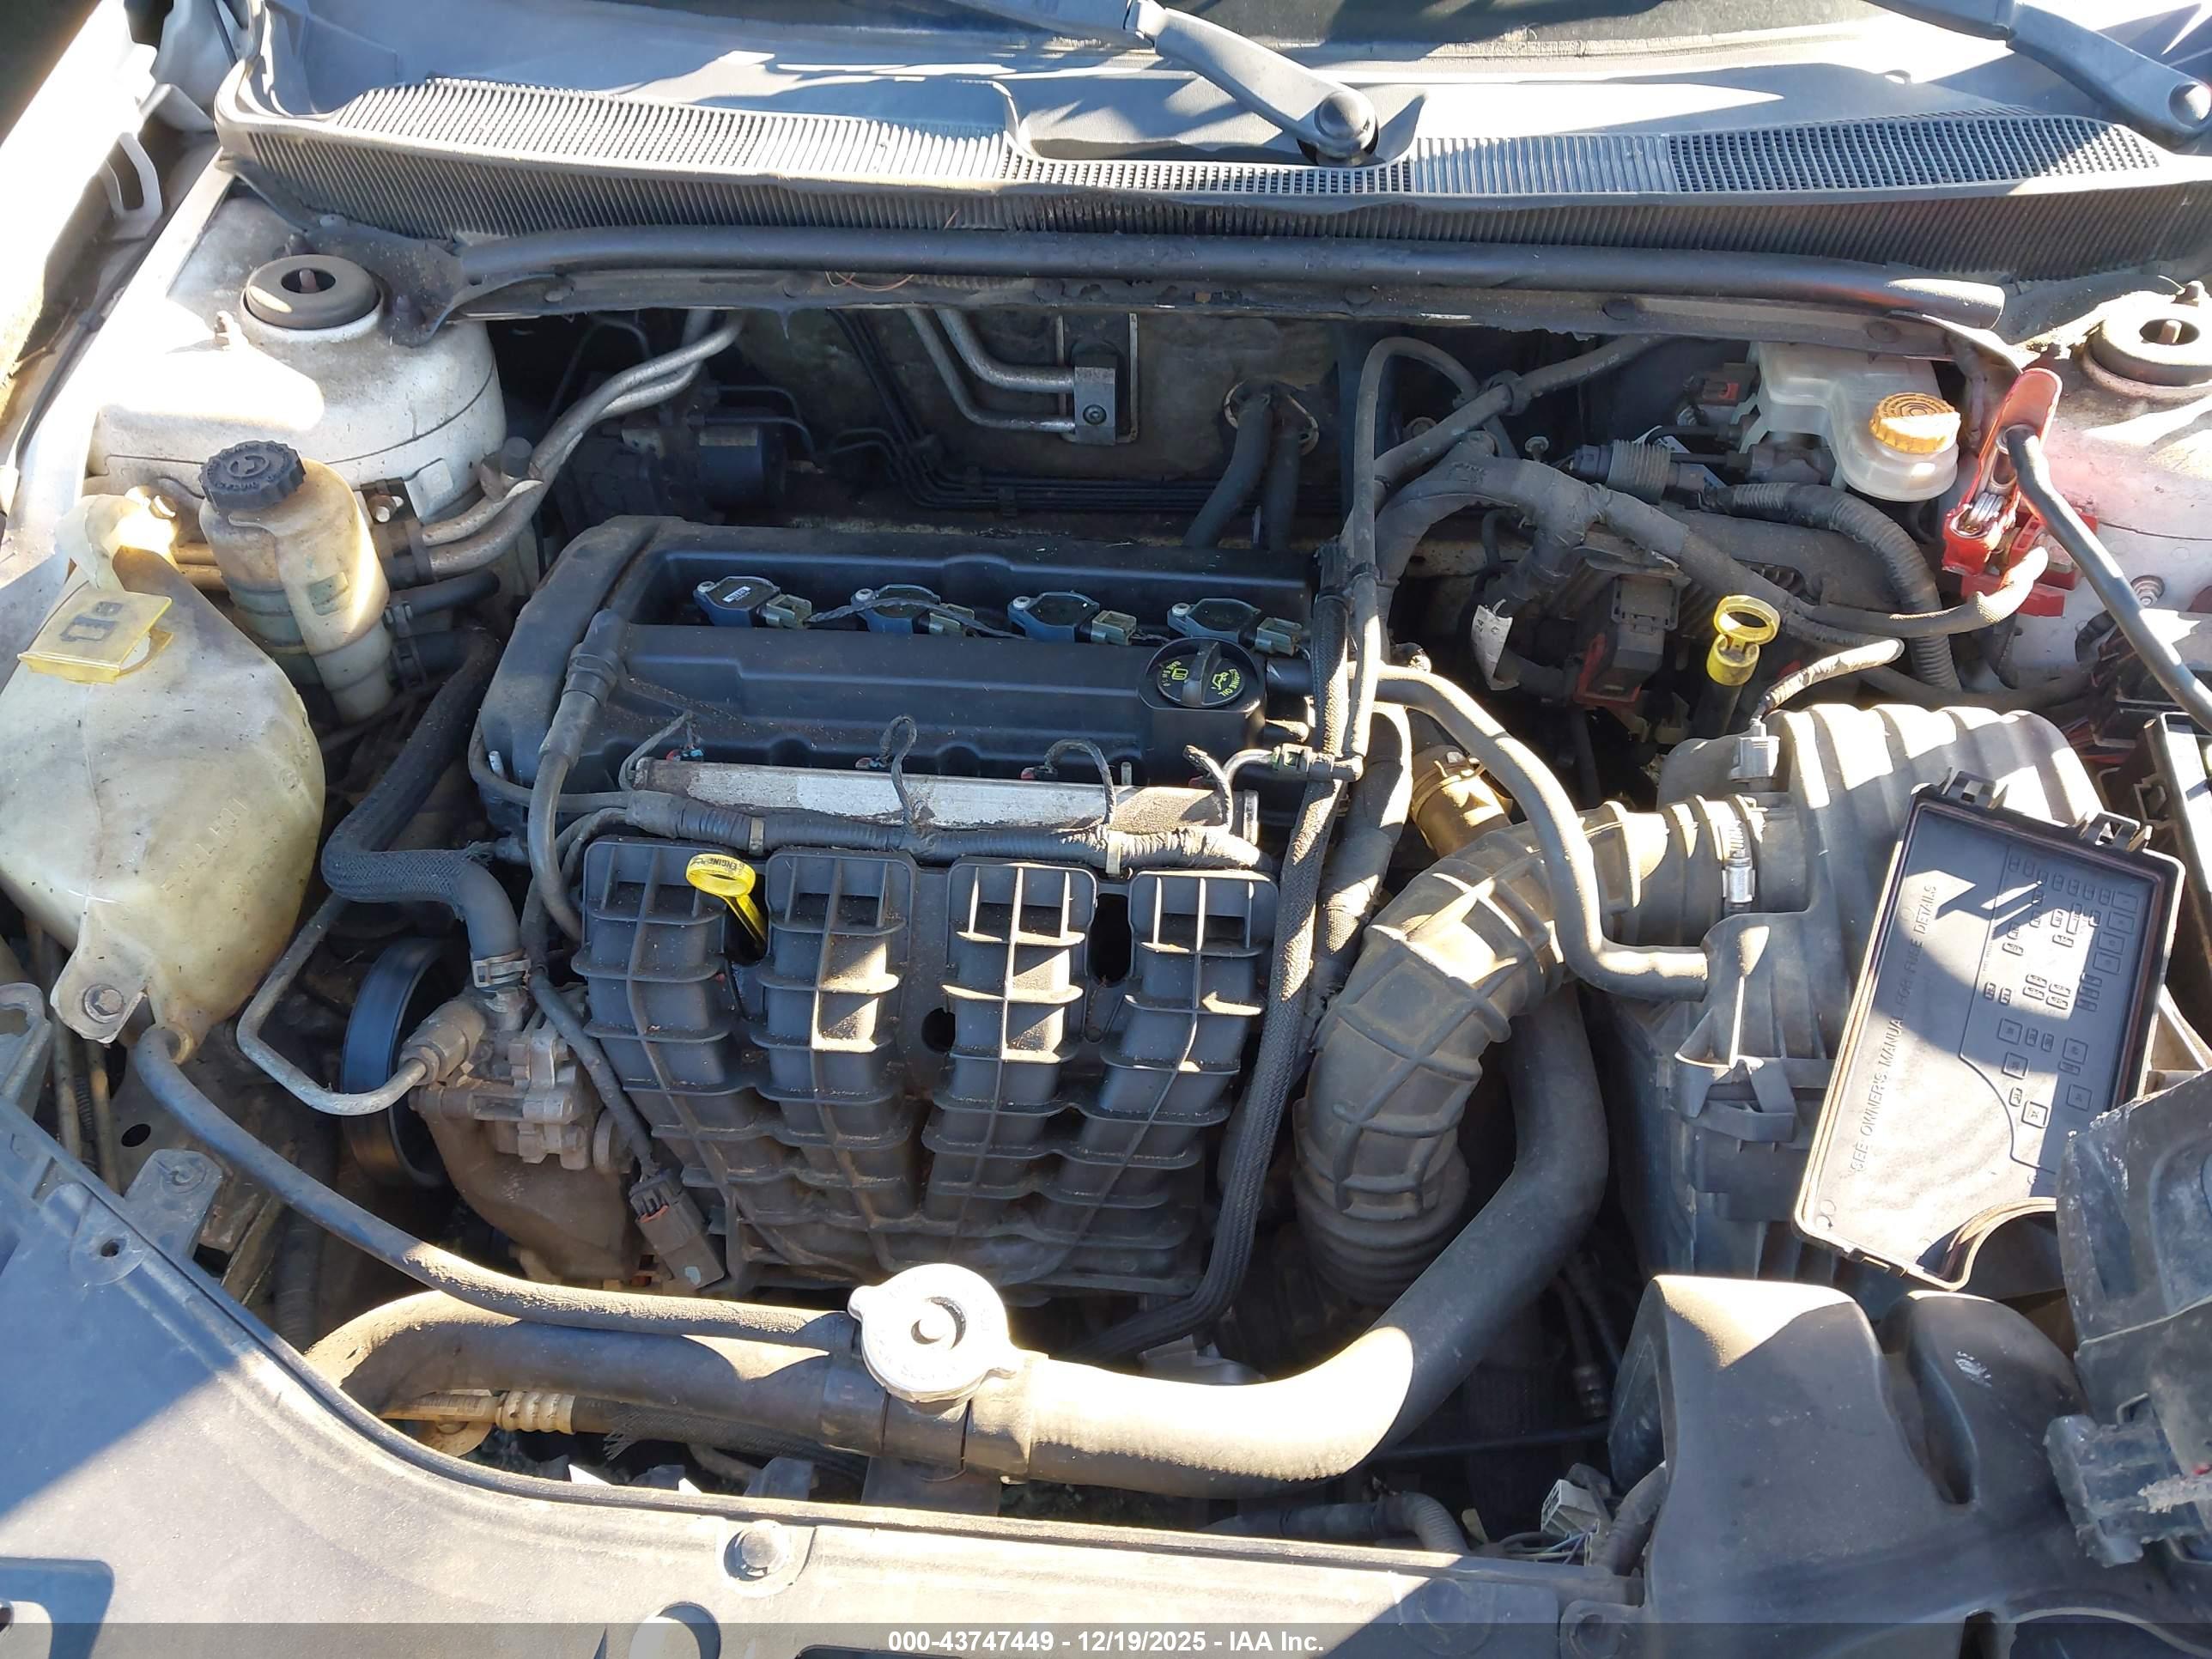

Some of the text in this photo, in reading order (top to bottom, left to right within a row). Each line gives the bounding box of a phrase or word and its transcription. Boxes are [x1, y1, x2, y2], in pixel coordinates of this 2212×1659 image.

[1218, 669, 1241, 696] ENGINE OIL
[708, 858, 738, 871] ENGINE
[1913, 885, 1937, 934] DETAILS
[1904, 938, 1923, 974] FUSE
[1860, 1073, 1888, 1136] OWNER'S
[1850, 1142, 1869, 1172] SEE
